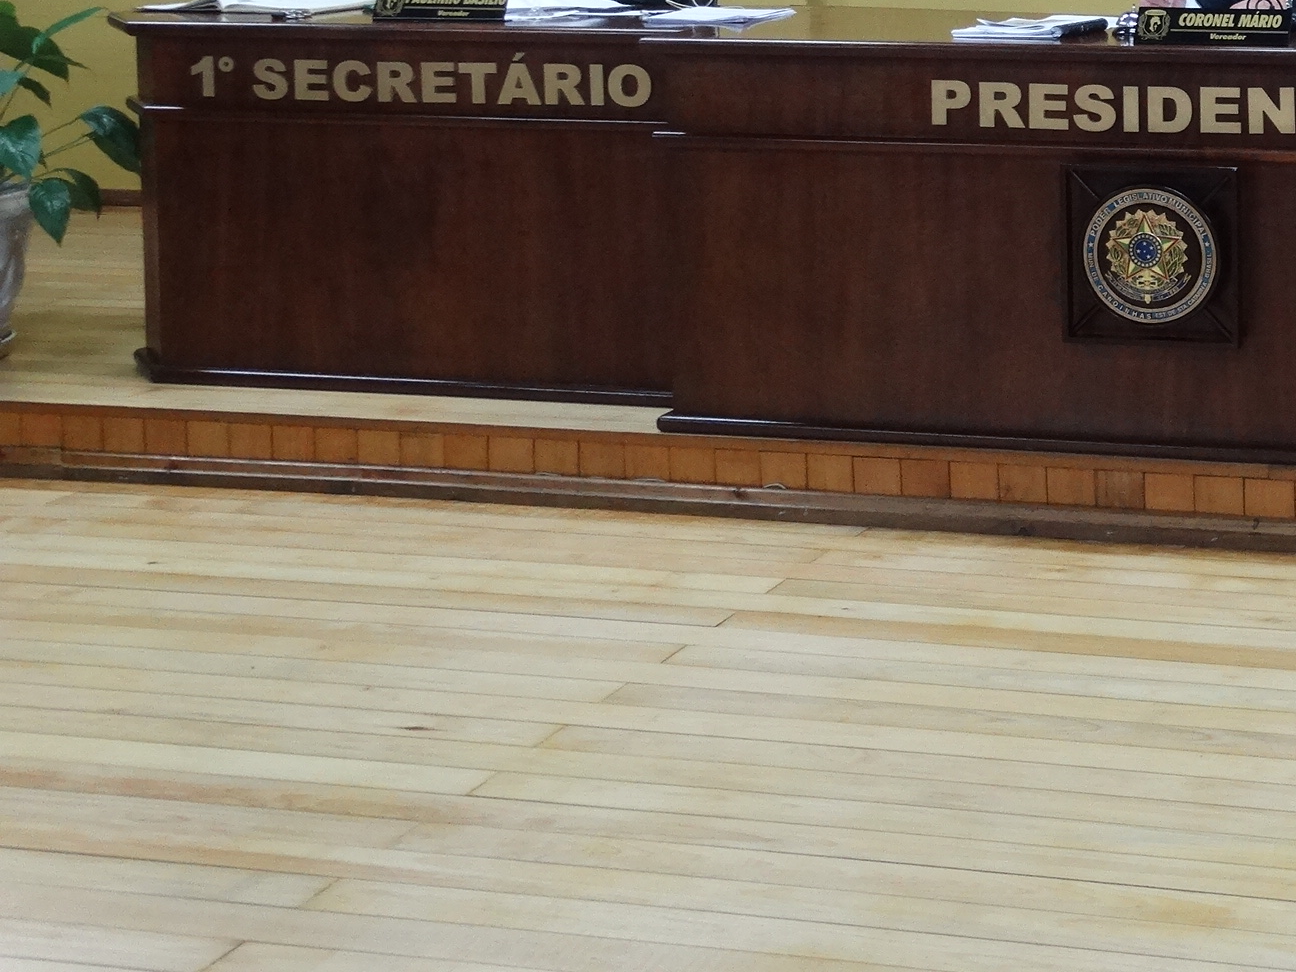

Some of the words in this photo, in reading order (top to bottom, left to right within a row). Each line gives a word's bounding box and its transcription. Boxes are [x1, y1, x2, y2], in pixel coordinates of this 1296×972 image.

[1178, 12, 1235, 27] CORONEL
[1237, 11, 1283, 28] MÁRIO
[252, 51, 653, 109] SECRETÁRIO
[1090, 207, 1111, 237] PODER
[1113, 192, 1168, 208] LEGISLATIVO
[1168, 198, 1208, 238] MUNICIPAL
[1097, 284, 1153, 319] CANOINHAS
